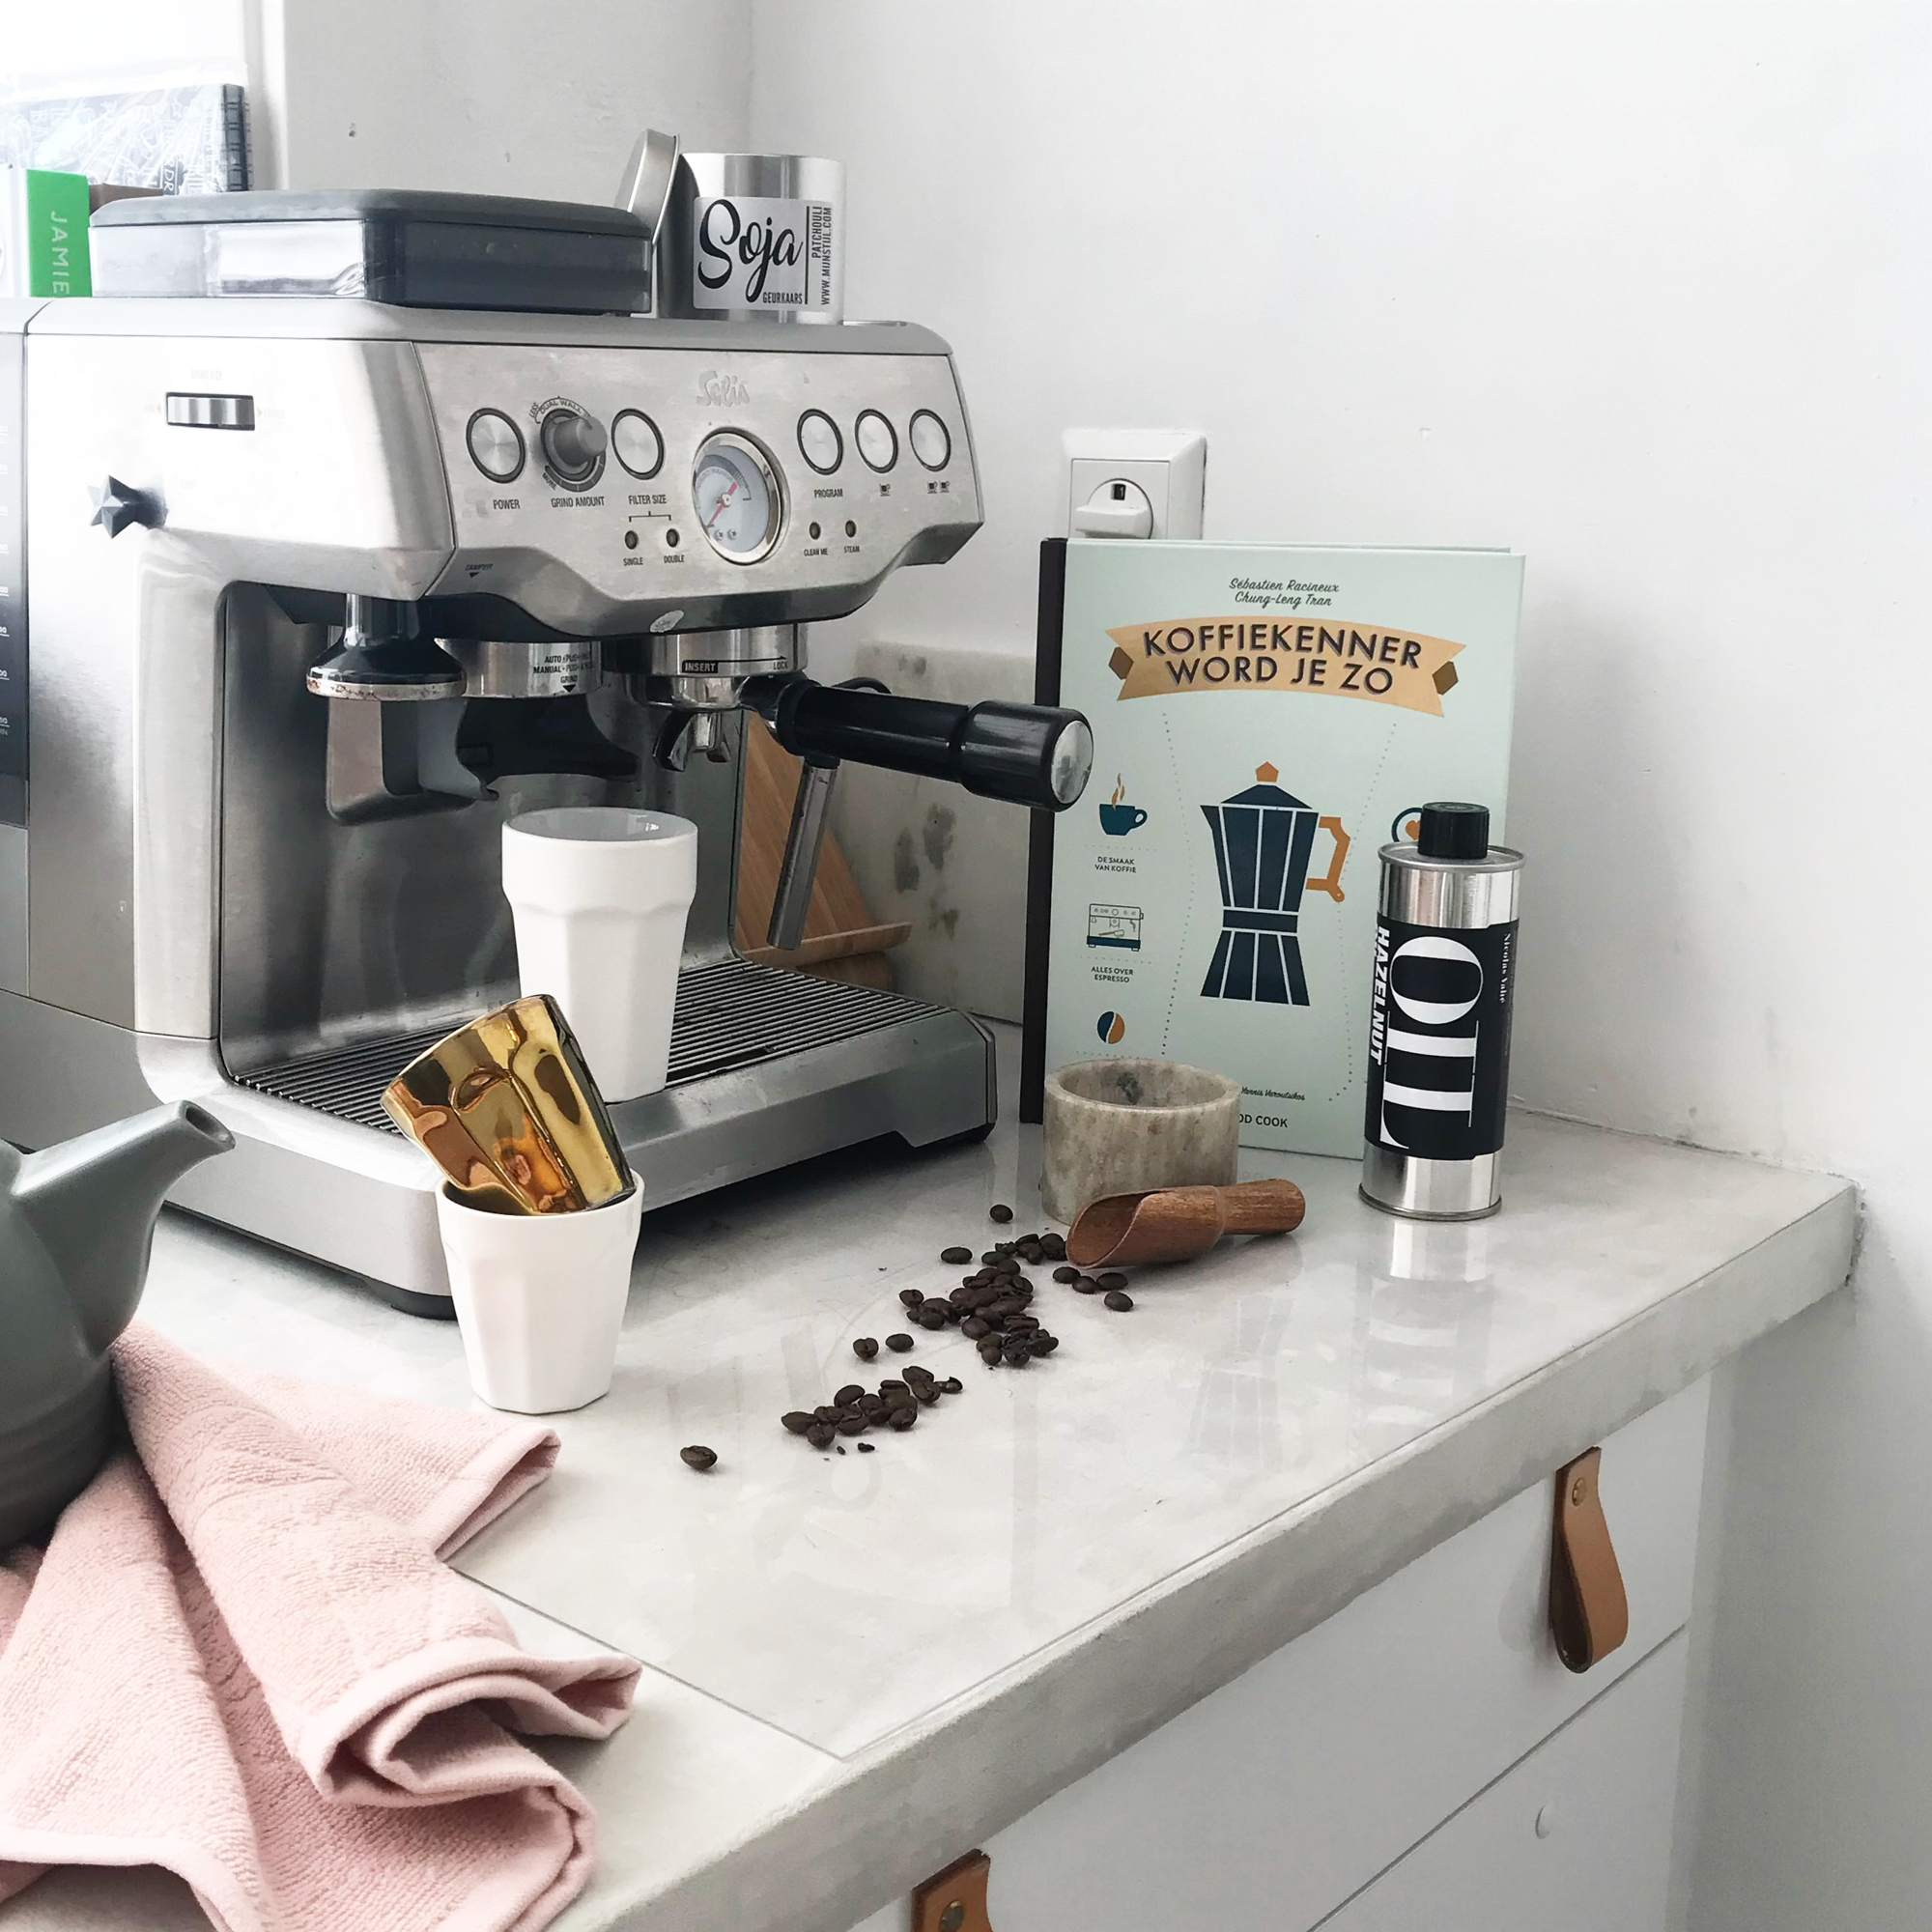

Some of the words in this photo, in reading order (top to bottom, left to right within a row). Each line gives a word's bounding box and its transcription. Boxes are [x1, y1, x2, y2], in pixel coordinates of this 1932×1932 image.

[812, 206, 823, 259] PATCHOULI
[50, 211, 70, 295] JAMIE
[697, 199, 804, 303] Soja
[762, 292, 804, 305] GEURKAARS
[696, 370, 750, 408] Solis
[813, 488, 843, 498] PROGRAM
[493, 498, 521, 510] POWER
[551, 497, 574, 508] GRIND
[575, 496, 605, 507] AMOUNT
[628, 495, 651, 505] FILTER
[652, 494, 668, 504] SIZE
[623, 556, 643, 567] SINGLE
[664, 554, 685, 564] DOUBLE
[1229, 577, 1283, 591] Sébastien
[1286, 579, 1340, 593] Racineux
[1235, 590, 1302, 610] Chung-Leng
[1305, 593, 1332, 607] Tran
[1142, 623, 1422, 669] KOFFIEKENNER
[545, 655, 562, 664] AUTO
[773, 661, 789, 670] LOCK
[533, 666, 562, 674] MANUAL
[684, 662, 717, 672] INSERT
[1165, 655, 1278, 687] WORD
[1290, 657, 1326, 686] JE
[1339, 662, 1394, 696] ZO
[1108, 857, 1135, 866] SMAAK
[1111, 865, 1137, 873] KOFFIE
[1091, 965, 1113, 974] ALLES
[1113, 967, 1134, 976] OVER
[1094, 974, 1130, 983] ESPRESSO
[1370, 924, 1391, 1065] HAZELNUT
[1379, 936, 1484, 1150] OIL
[1255, 1115, 1289, 1128] COOK
